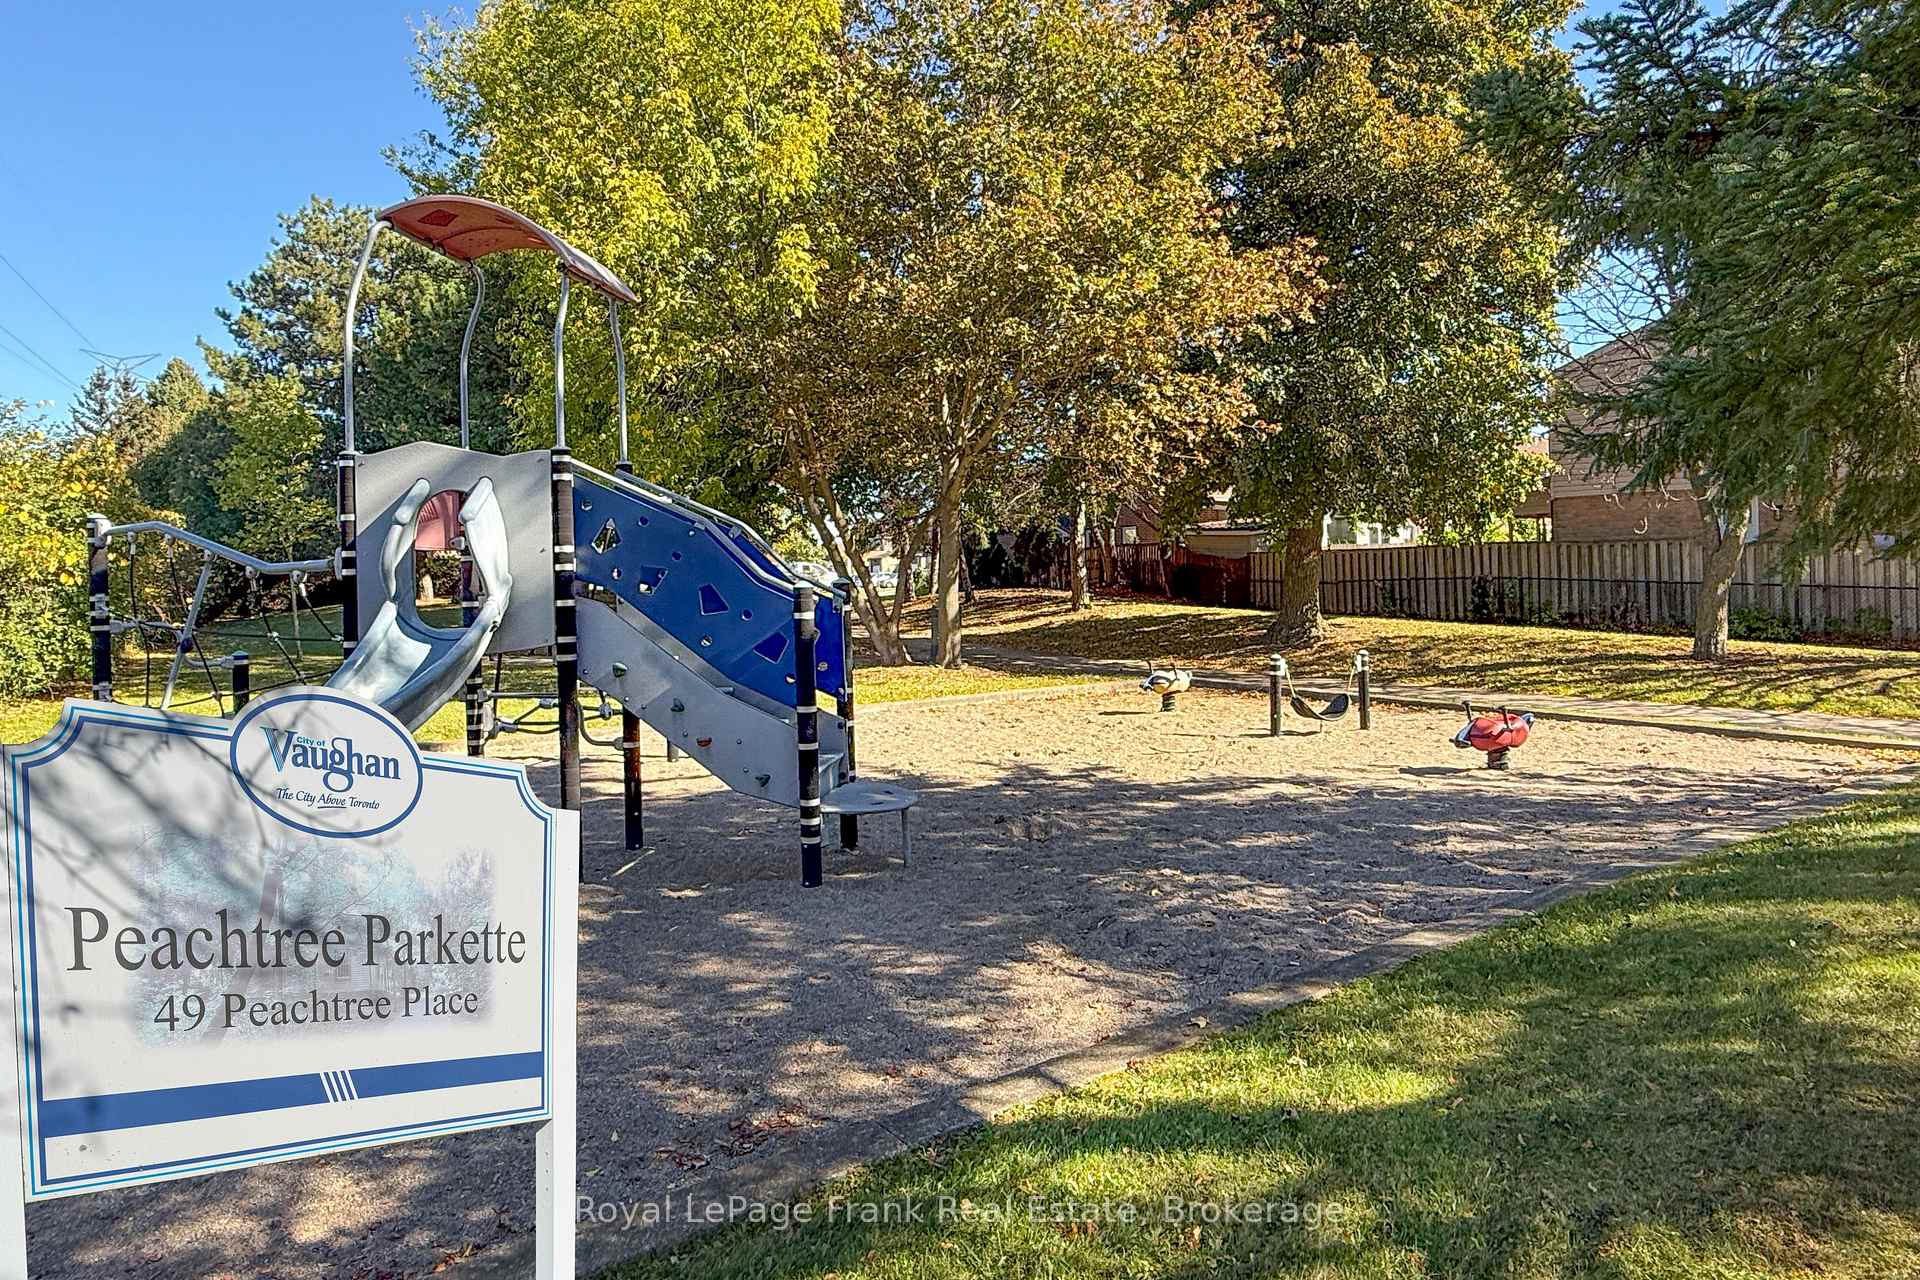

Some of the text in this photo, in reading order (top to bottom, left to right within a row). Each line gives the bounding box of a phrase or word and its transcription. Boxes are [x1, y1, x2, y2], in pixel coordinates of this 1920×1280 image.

[260, 727, 401, 793] Vaughan
[296, 736, 326, 747] City of
[276, 788, 380, 809] The City Above Toronto
[64, 907, 526, 971] Peachtree Parkette
[153, 986, 478, 1032] 49 Peachtree Place
